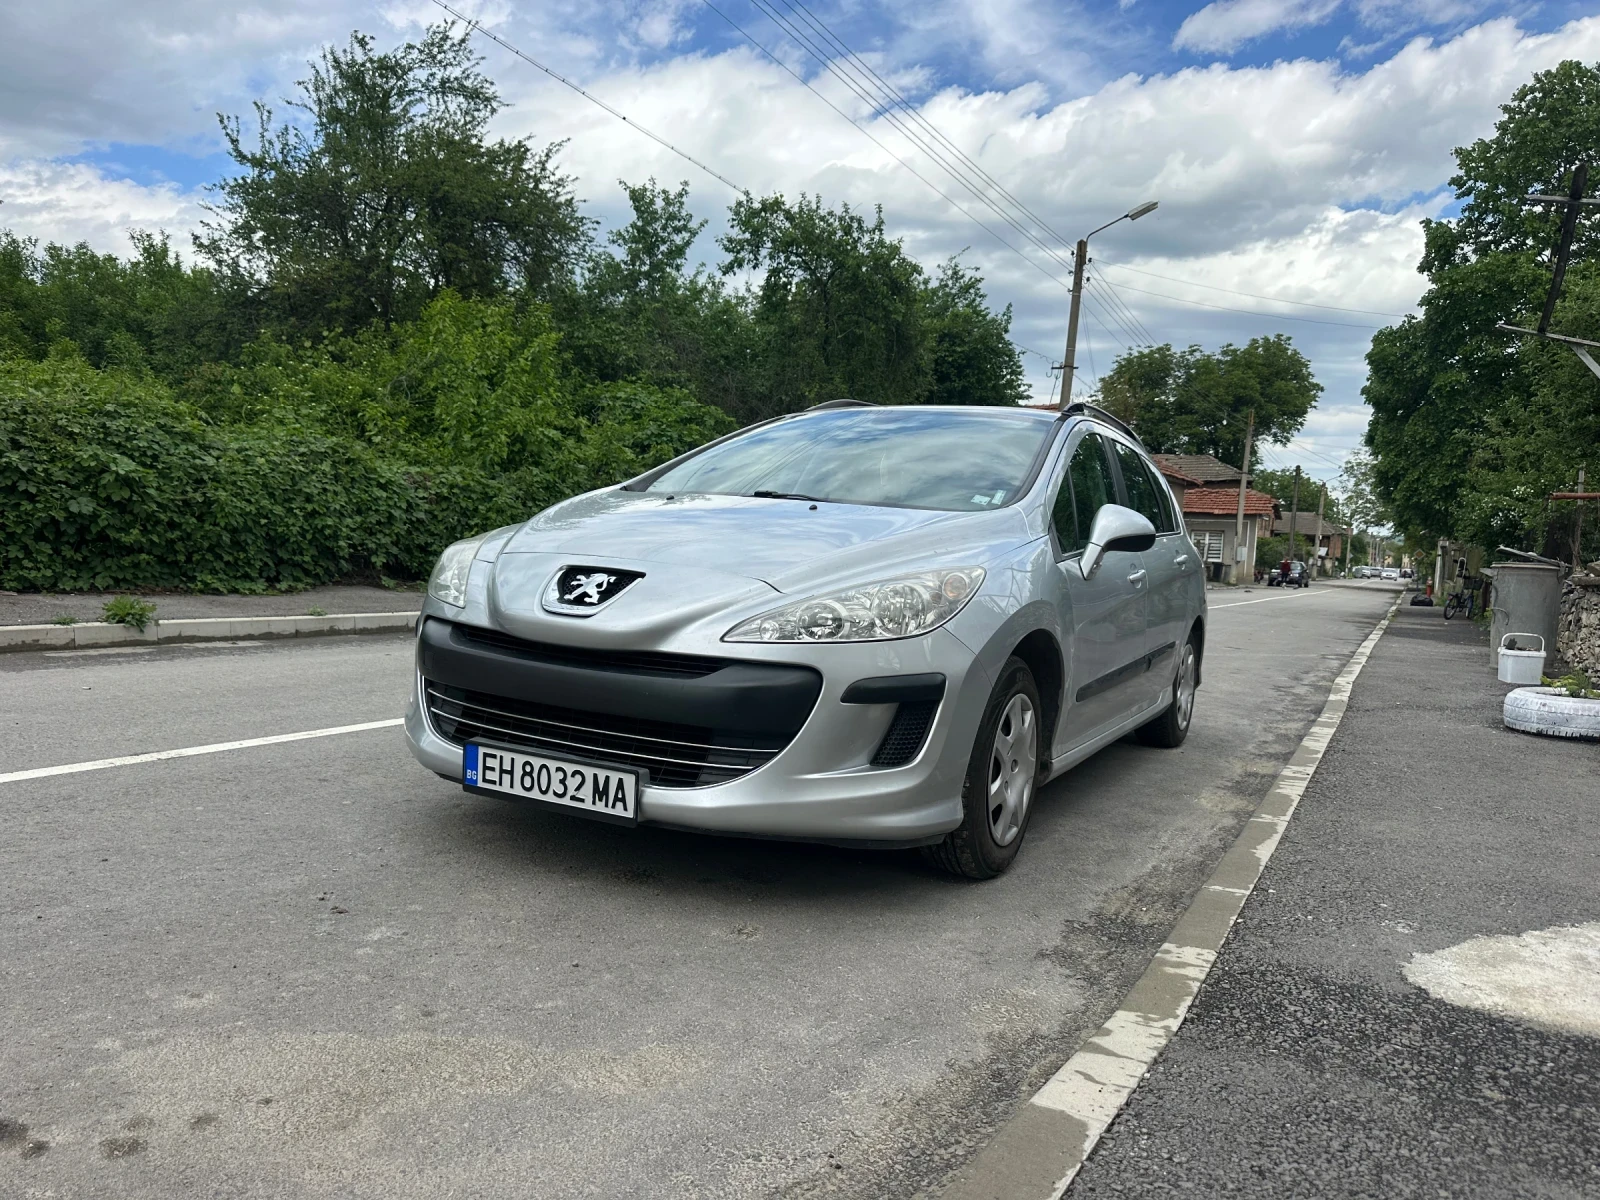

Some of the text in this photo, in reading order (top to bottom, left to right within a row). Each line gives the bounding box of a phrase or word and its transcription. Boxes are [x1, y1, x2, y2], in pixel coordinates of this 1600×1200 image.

[466, 769, 477, 780] BG
[482, 752, 628, 812] EH 8032 MA
